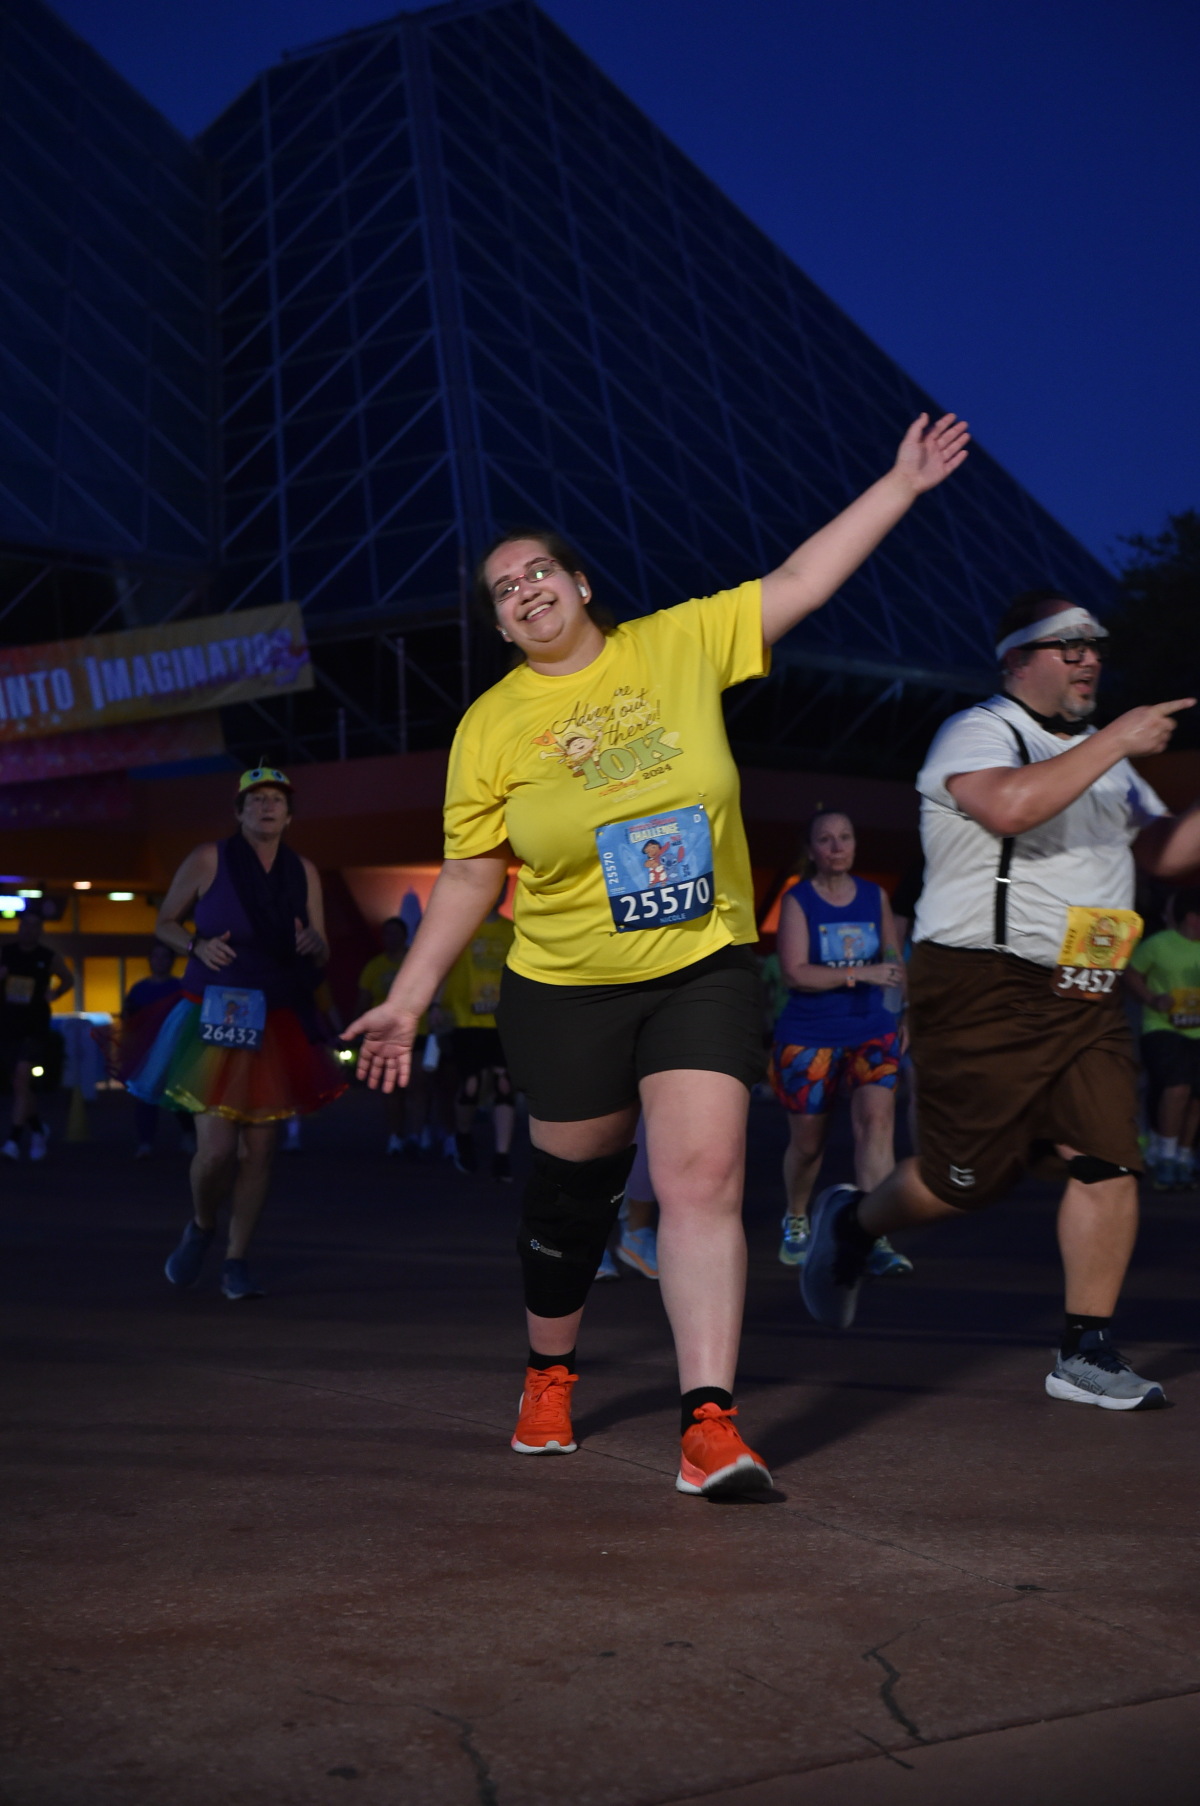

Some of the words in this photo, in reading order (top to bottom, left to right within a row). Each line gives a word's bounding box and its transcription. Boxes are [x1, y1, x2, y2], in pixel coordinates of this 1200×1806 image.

[584, 727, 684, 791] 10K
[642, 763, 673, 780] 2024
[602, 851, 620, 885] 25570
[619, 877, 711, 923] 25570
[202, 1023, 258, 1046] 26432
